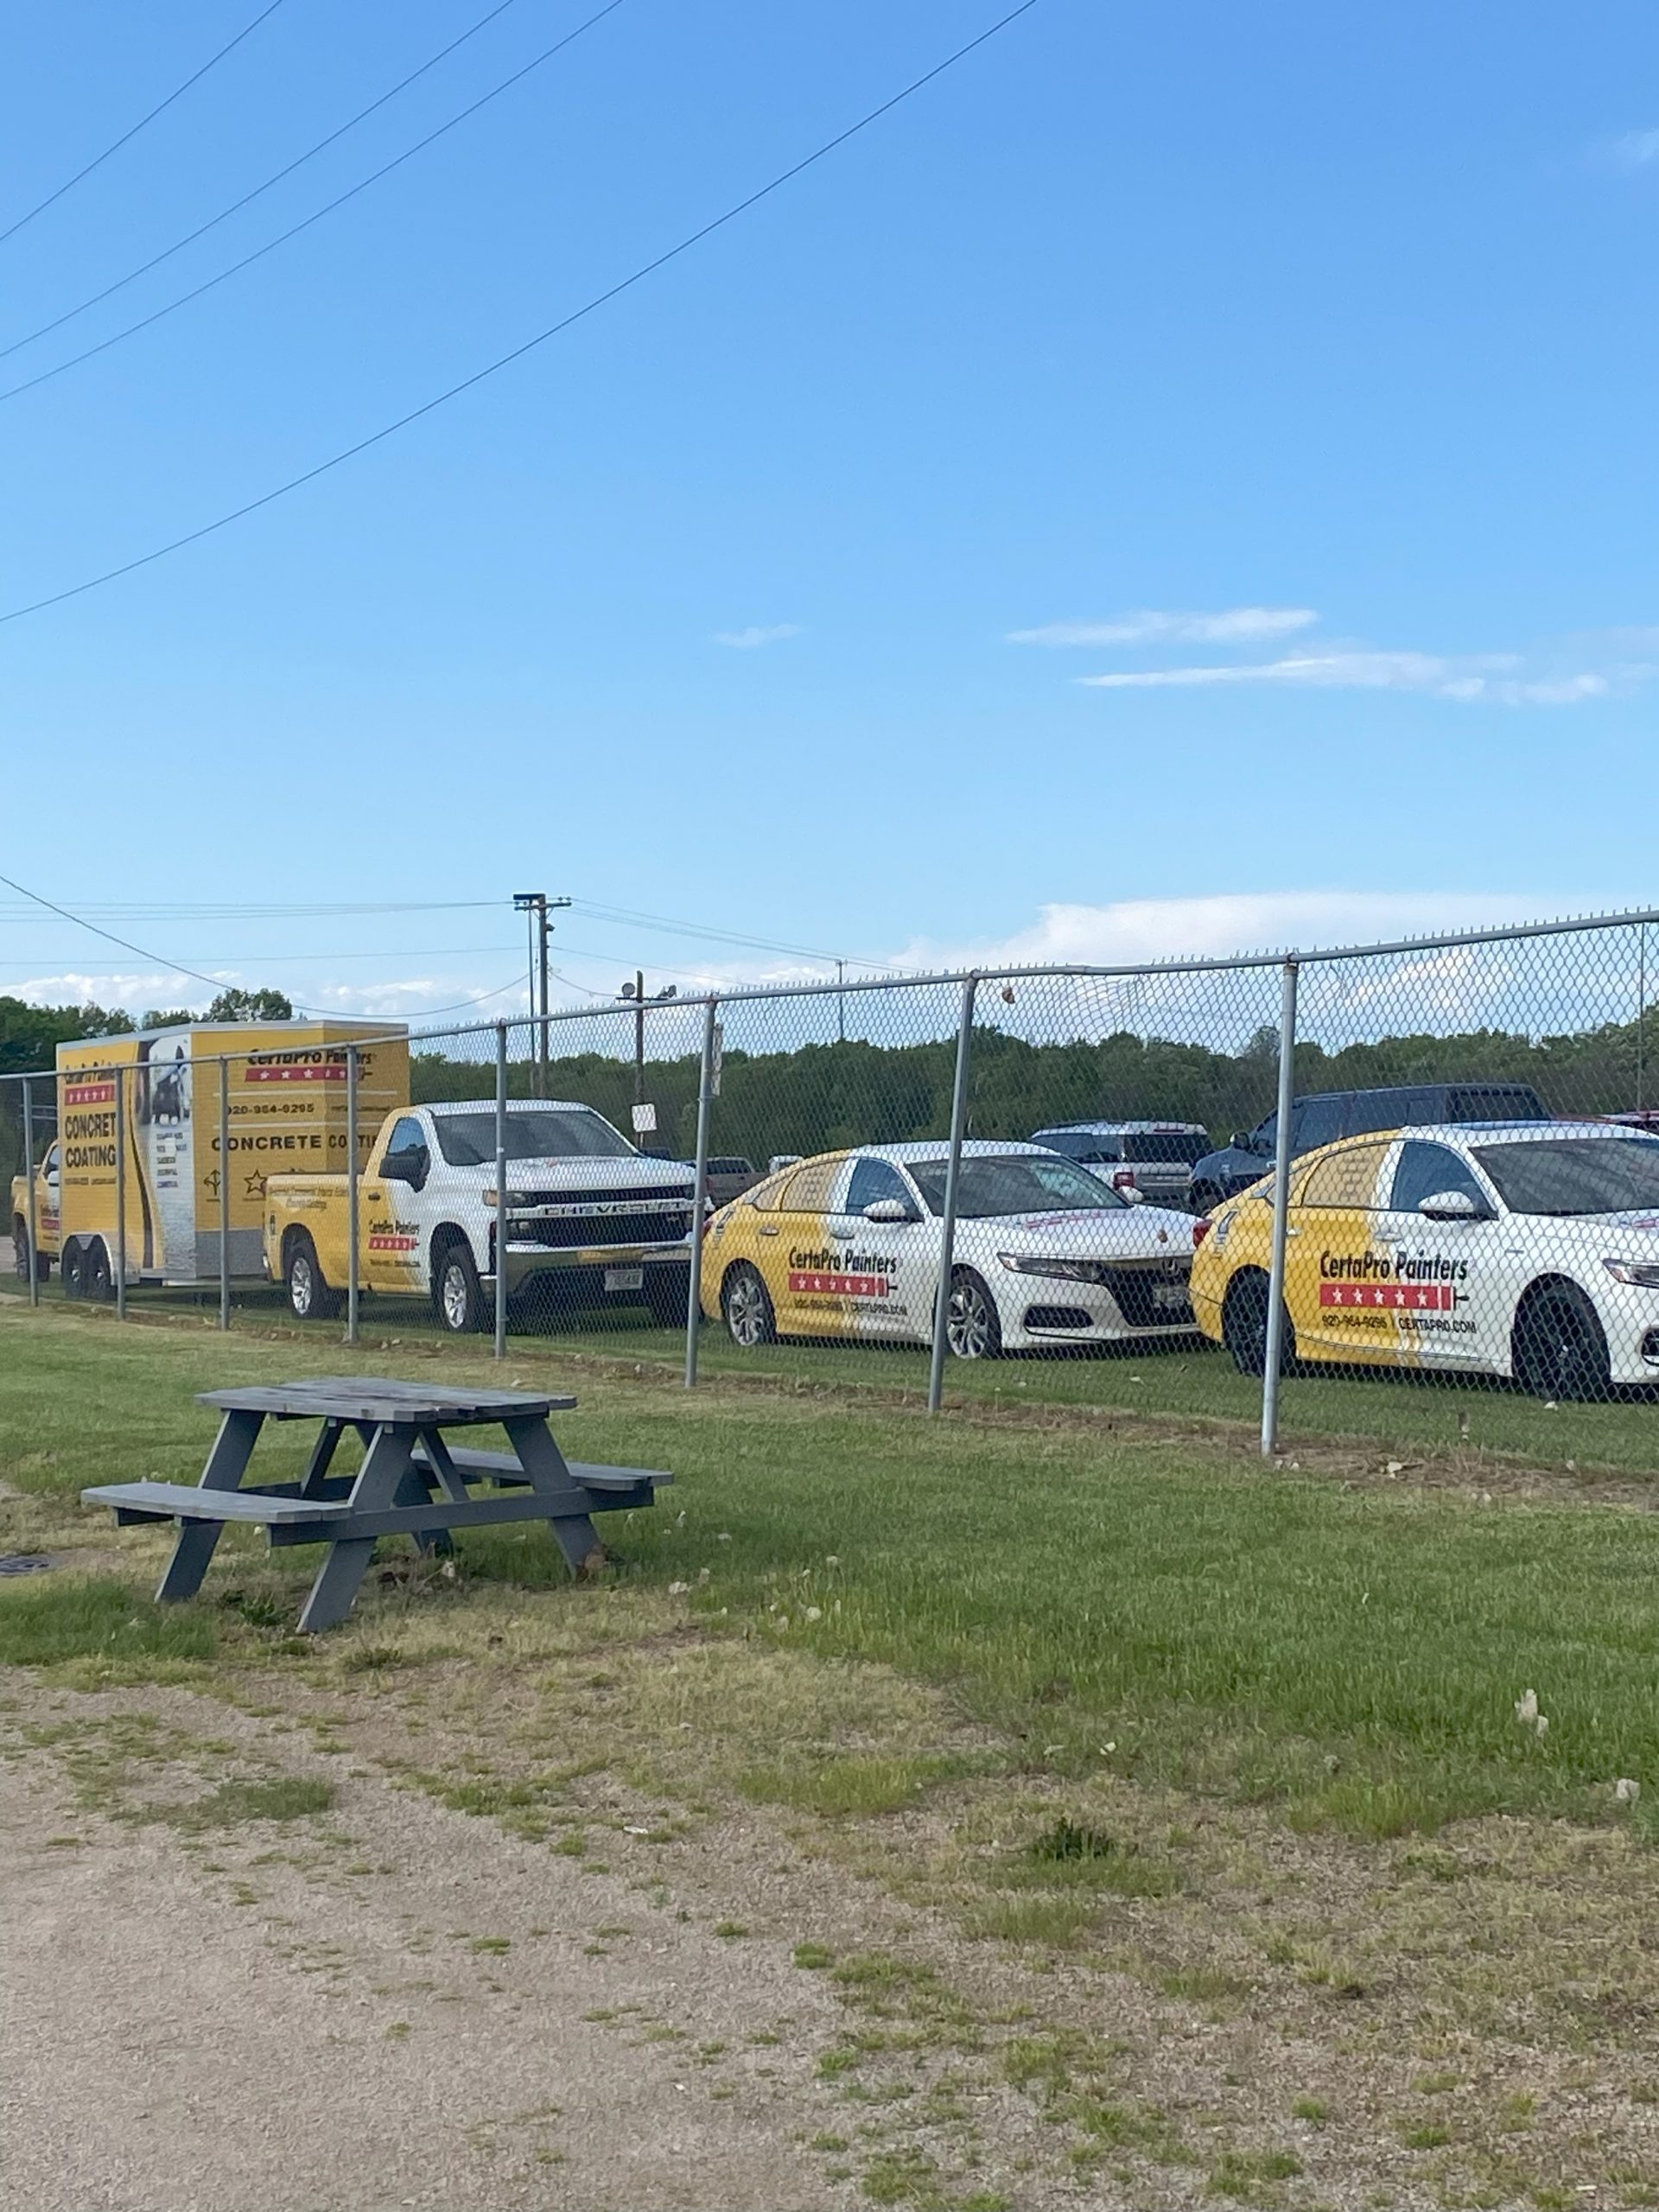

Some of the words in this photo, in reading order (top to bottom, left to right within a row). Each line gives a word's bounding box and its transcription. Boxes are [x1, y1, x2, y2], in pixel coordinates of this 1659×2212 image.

[326, 1046, 372, 1065] Paiers
[65, 1111, 116, 1140] CONCRET
[211, 1135, 322, 1151] CONCRETE
[328, 1135, 377, 1149] COTI
[544, 1201, 683, 1216] CHEVROLET
[788, 1246, 842, 1271] CertaPro
[844, 1248, 898, 1274] Painters
[1319, 1249, 1390, 1279] CertaPro
[1395, 1249, 1469, 1281] Painters
[1398, 1317, 1478, 1334] CERTAPRO.COM
